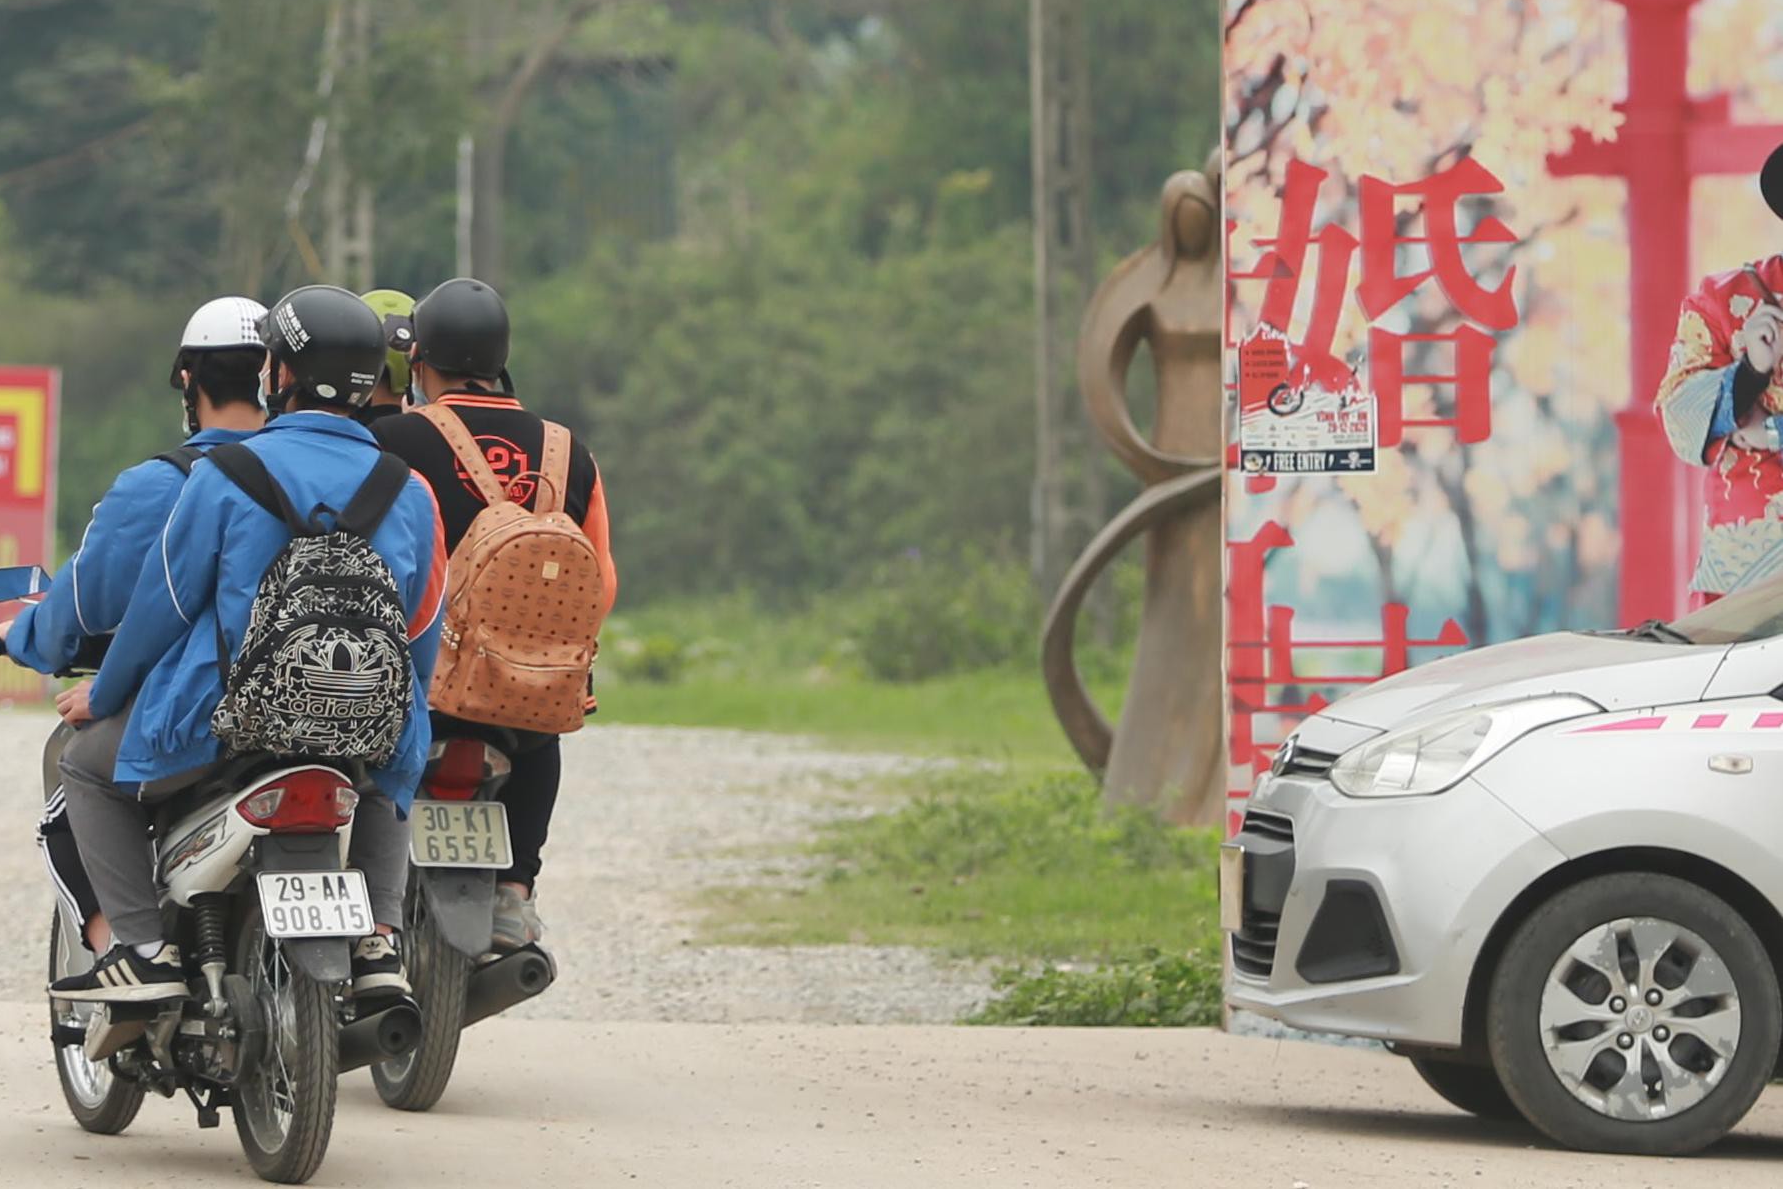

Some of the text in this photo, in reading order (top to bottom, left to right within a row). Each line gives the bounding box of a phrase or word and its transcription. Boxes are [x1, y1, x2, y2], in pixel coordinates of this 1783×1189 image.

[1273, 451, 1327, 471] FREE ENTRY
[288, 694, 386, 718] adidas
[423, 806, 493, 834] 30-K1
[426, 835, 497, 863] 6554
[274, 875, 351, 902] 29-AA
[272, 903, 366, 932] 908.15
